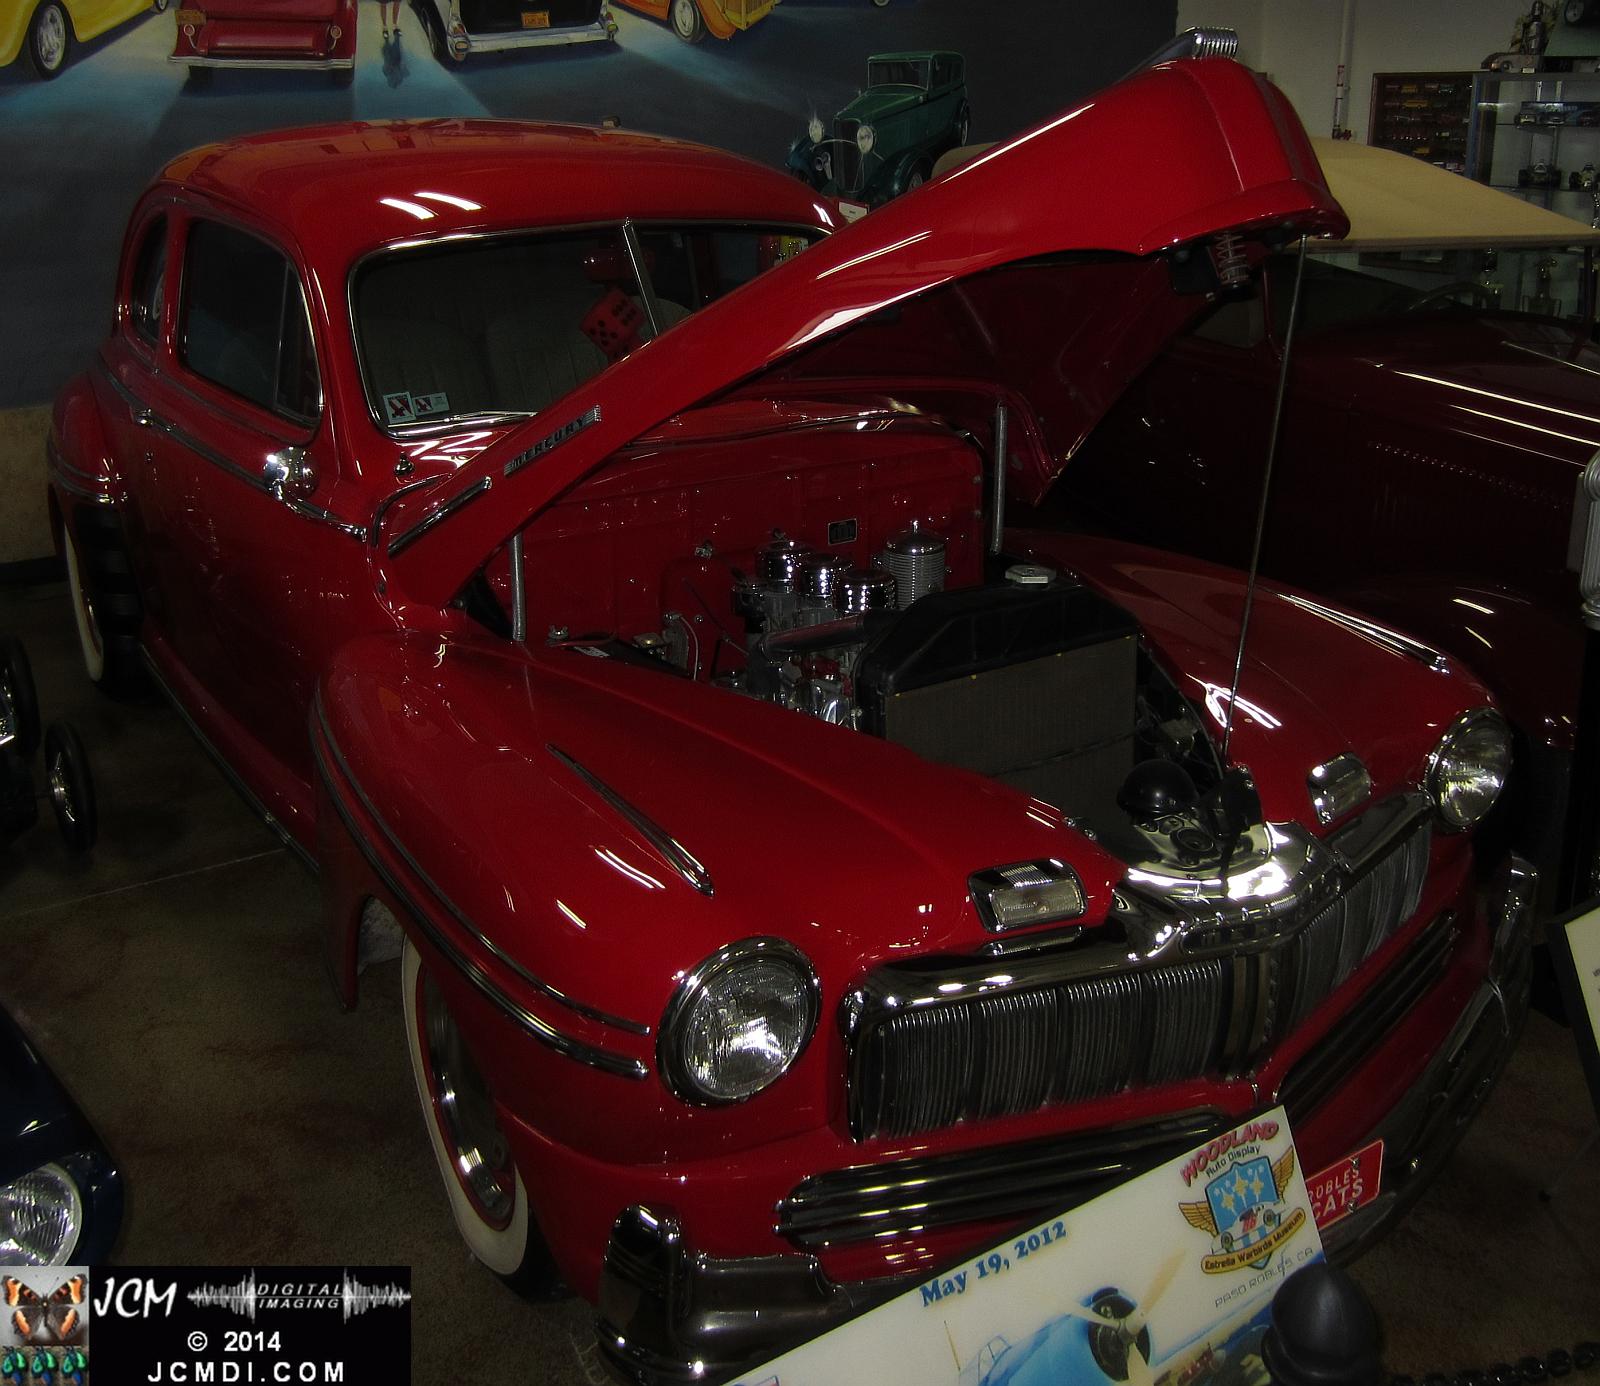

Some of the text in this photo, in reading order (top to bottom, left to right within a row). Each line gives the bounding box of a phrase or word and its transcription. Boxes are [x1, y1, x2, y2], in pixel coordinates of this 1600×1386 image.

[511, 415, 584, 468] MERCURY
[1180, 1120, 1279, 1187] WOODLAND
[1206, 1144, 1261, 1178] Auto Display
[919, 1221, 1067, 1307] May 19, 2012
[1204, 1256, 1236, 1270] Estrella
[1237, 1241, 1273, 1263] Warbirds
[1273, 1211, 1303, 1242] Museum
[1215, 1284, 1247, 1308] PASO
[1297, 1247, 1313, 1262] CA
